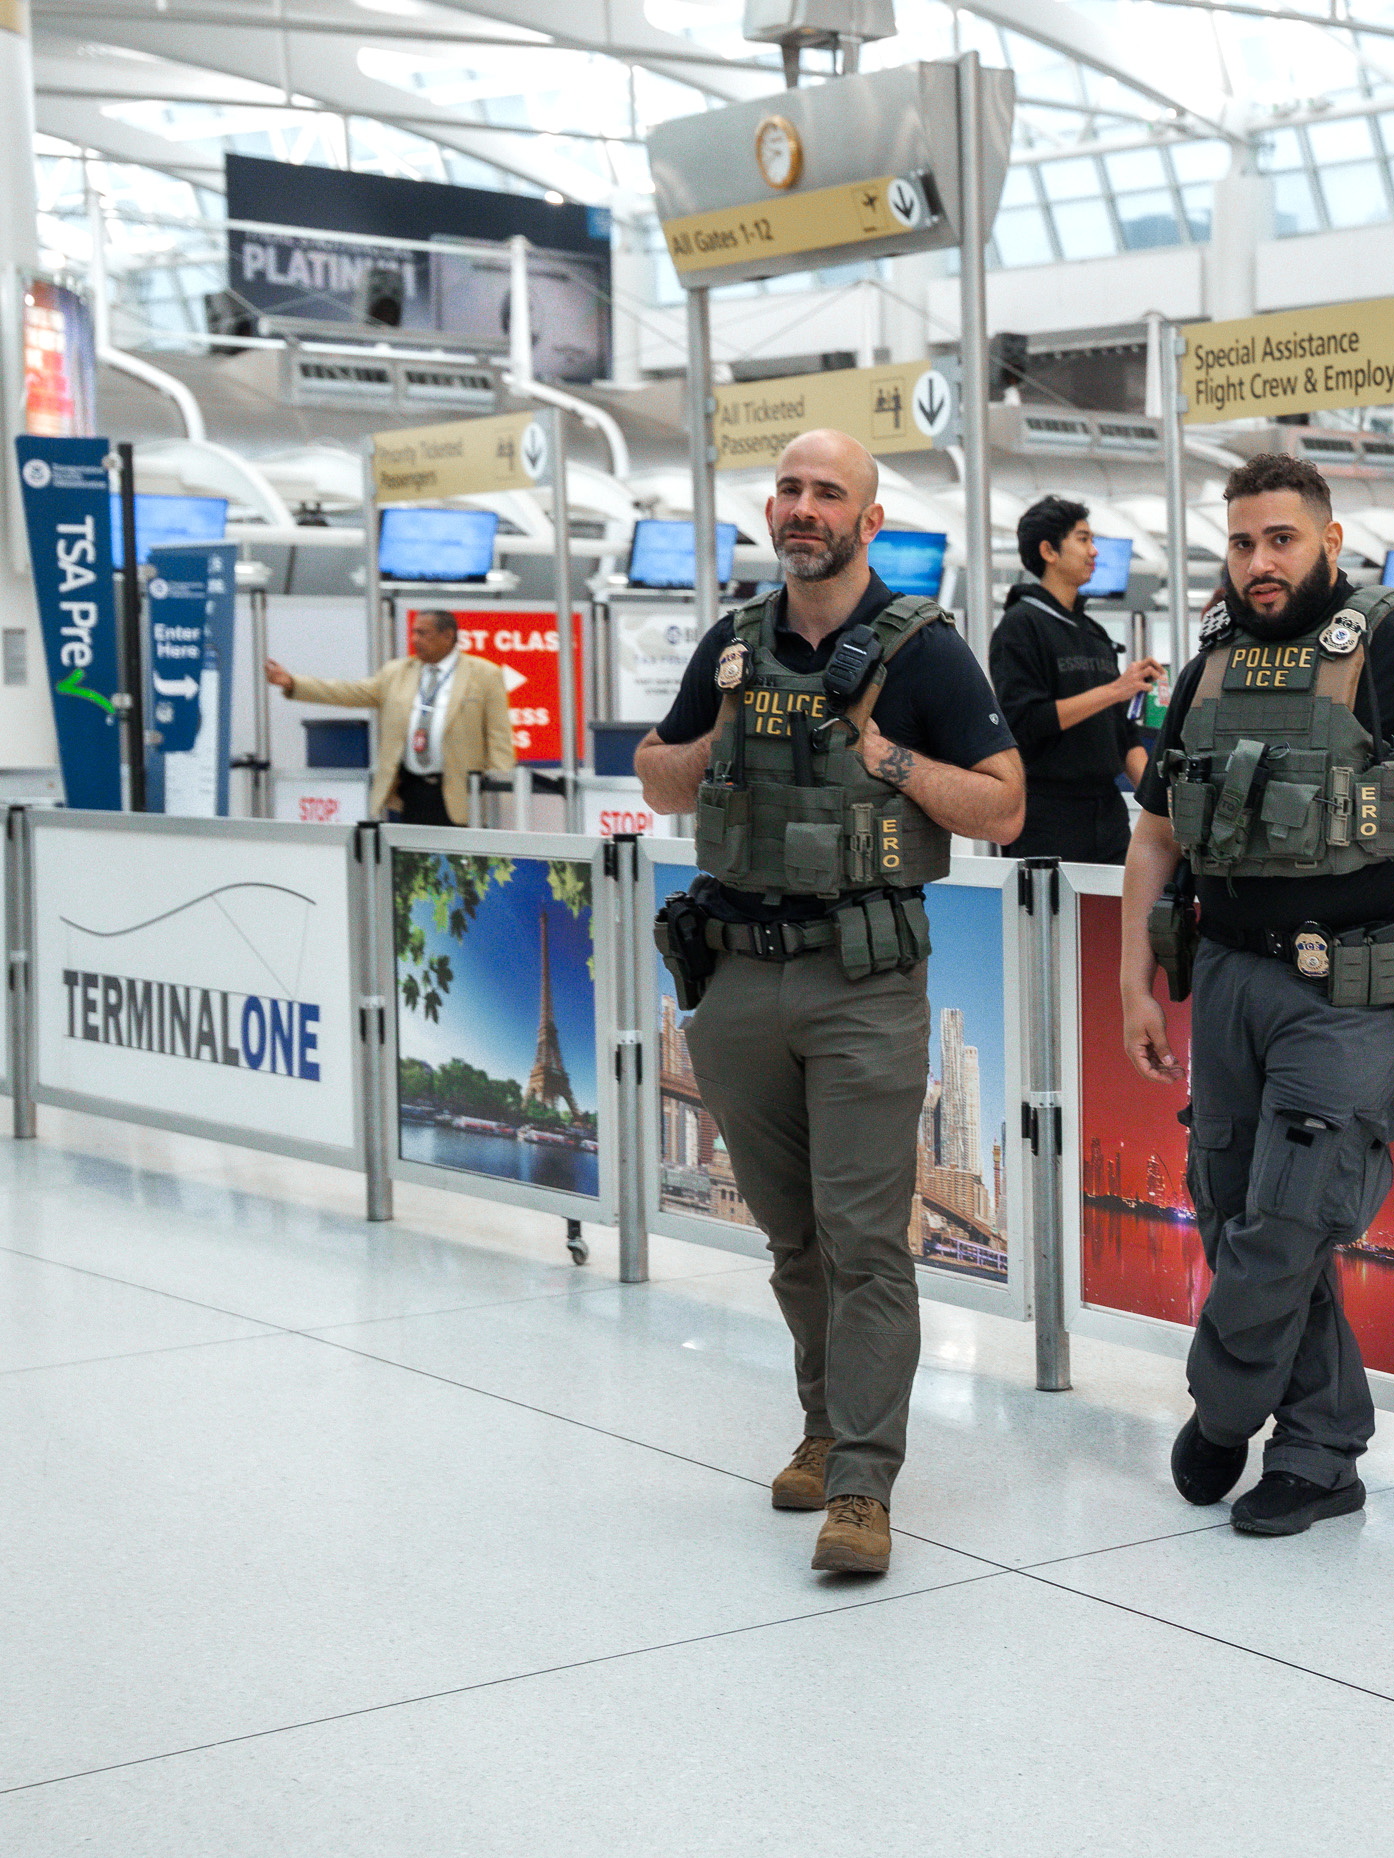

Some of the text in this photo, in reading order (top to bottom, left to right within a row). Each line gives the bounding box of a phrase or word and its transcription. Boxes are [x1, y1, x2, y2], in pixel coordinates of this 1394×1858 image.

[672, 218, 774, 256] All Gates 1-12
[242, 242, 417, 299] PLATIN
[1195, 331, 1360, 375] Special Assistance
[1196, 375, 1246, 411] Flight
[1250, 373, 1298, 400] Crew
[1304, 367, 1318, 394] &
[722, 394, 805, 425] All Ticketed
[56, 515, 97, 593] TSA
[59, 600, 98, 667] Pre
[154, 623, 200, 641] Enter
[157, 642, 199, 659] Here
[494, 630, 562, 651] CLAS
[1231, 647, 1315, 668] POLICE
[1245, 670, 1290, 687] ICE
[601, 811, 654, 837] STOP!
[1360, 787, 1377, 836] ERO
[882, 819, 900, 868] ERO
